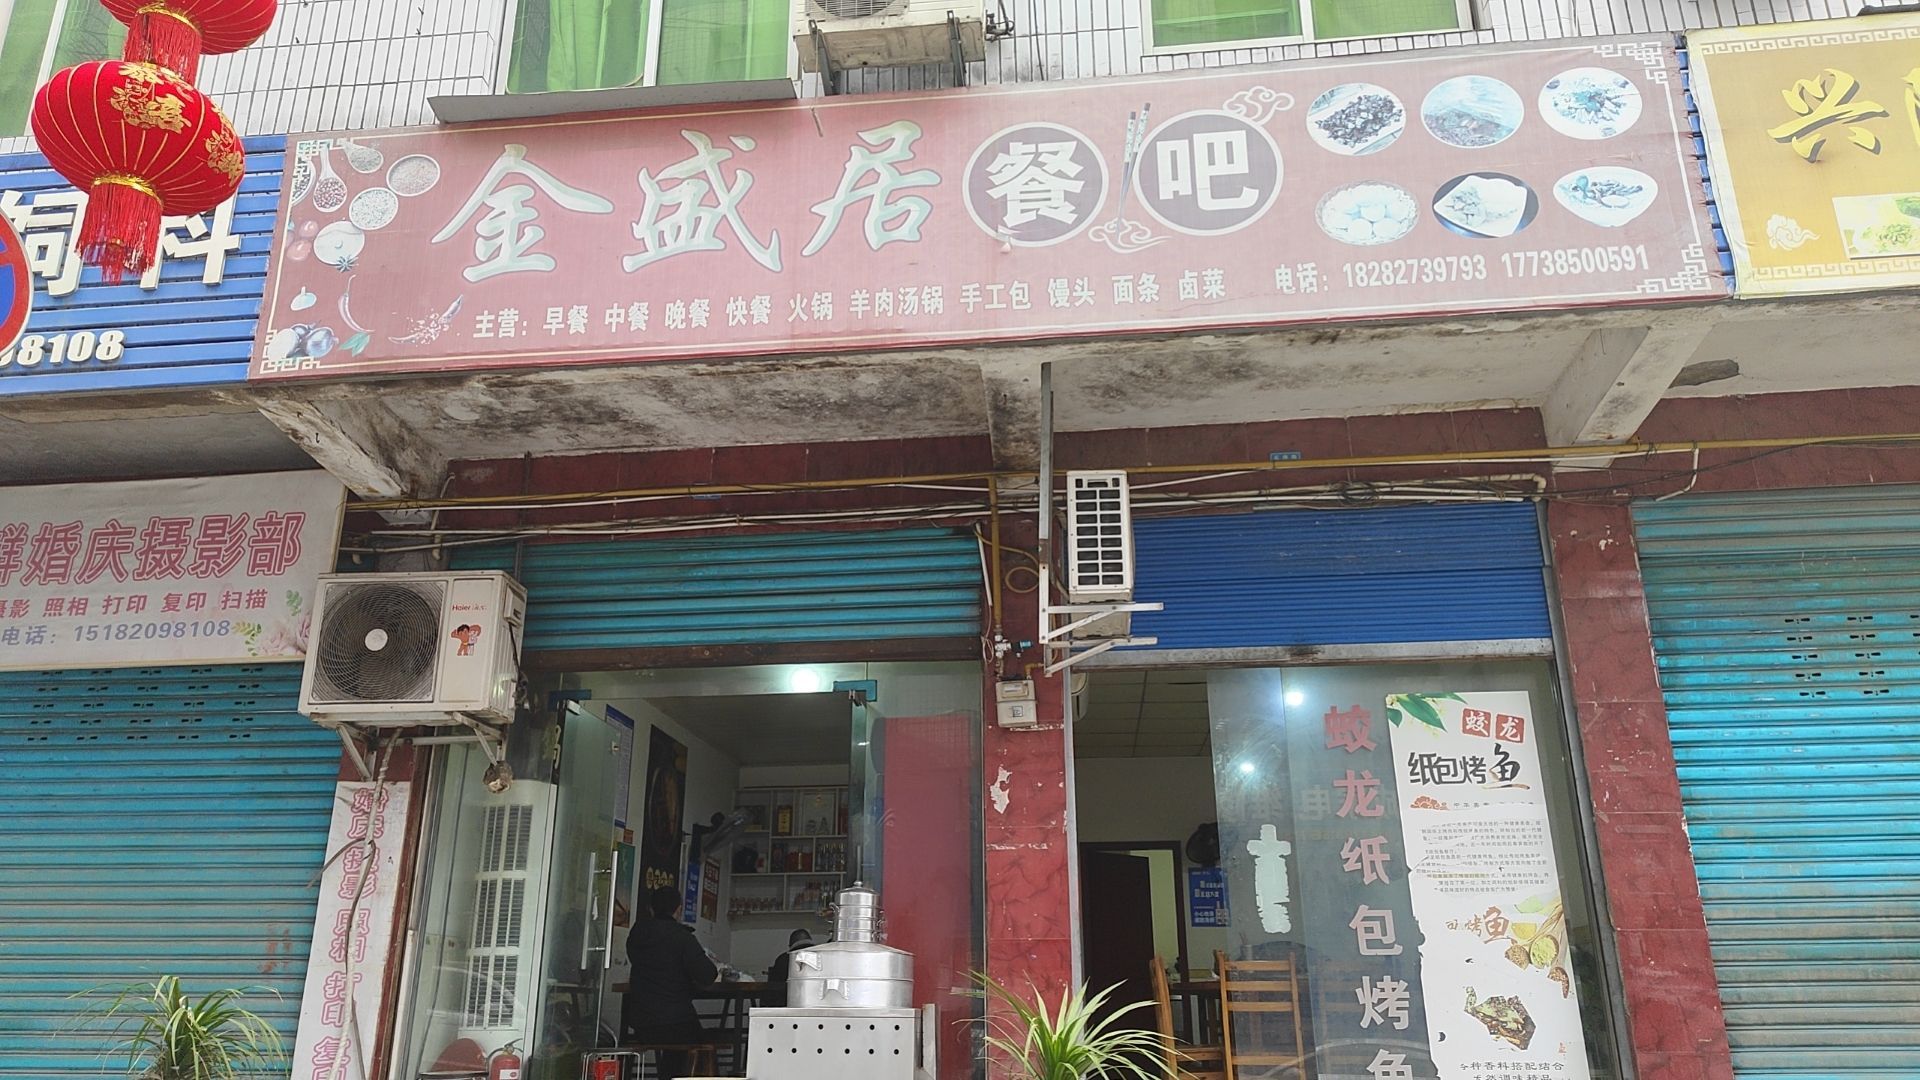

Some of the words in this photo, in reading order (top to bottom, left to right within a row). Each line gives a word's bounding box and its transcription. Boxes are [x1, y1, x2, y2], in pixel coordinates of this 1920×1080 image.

[1766, 67, 1920, 164] 兴
[430, 120, 942, 284] 金盛居
[985, 129, 1261, 228] 餐吧
[1342, 254, 1488, 288] 18282739793
[1501, 244, 1650, 279] 17738500591
[542, 304, 589, 336] 早餐
[604, 301, 649, 333] 中餐
[664, 297, 711, 330] 晚餐
[725, 294, 772, 327] 快餐
[787, 290, 833, 322] 火锅
[848, 285, 945, 319] 羊肉汤锅
[959, 280, 1032, 314] 手工包
[1046, 277, 1097, 309] 馒头
[1111, 272, 1161, 305] 面条
[1177, 268, 1227, 300] 卤菜
[0, 328, 126, 367] 8108
[42, 596, 89, 618] 照相
[101, 593, 148, 616] 打印
[160, 591, 208, 613] 复印
[220, 588, 269, 611] 扫描
[74, 619, 231, 643] 15182098108
[1462, 708, 1524, 743] 蛟龙
[1407, 742, 1530, 790] 纸包烤鱼
